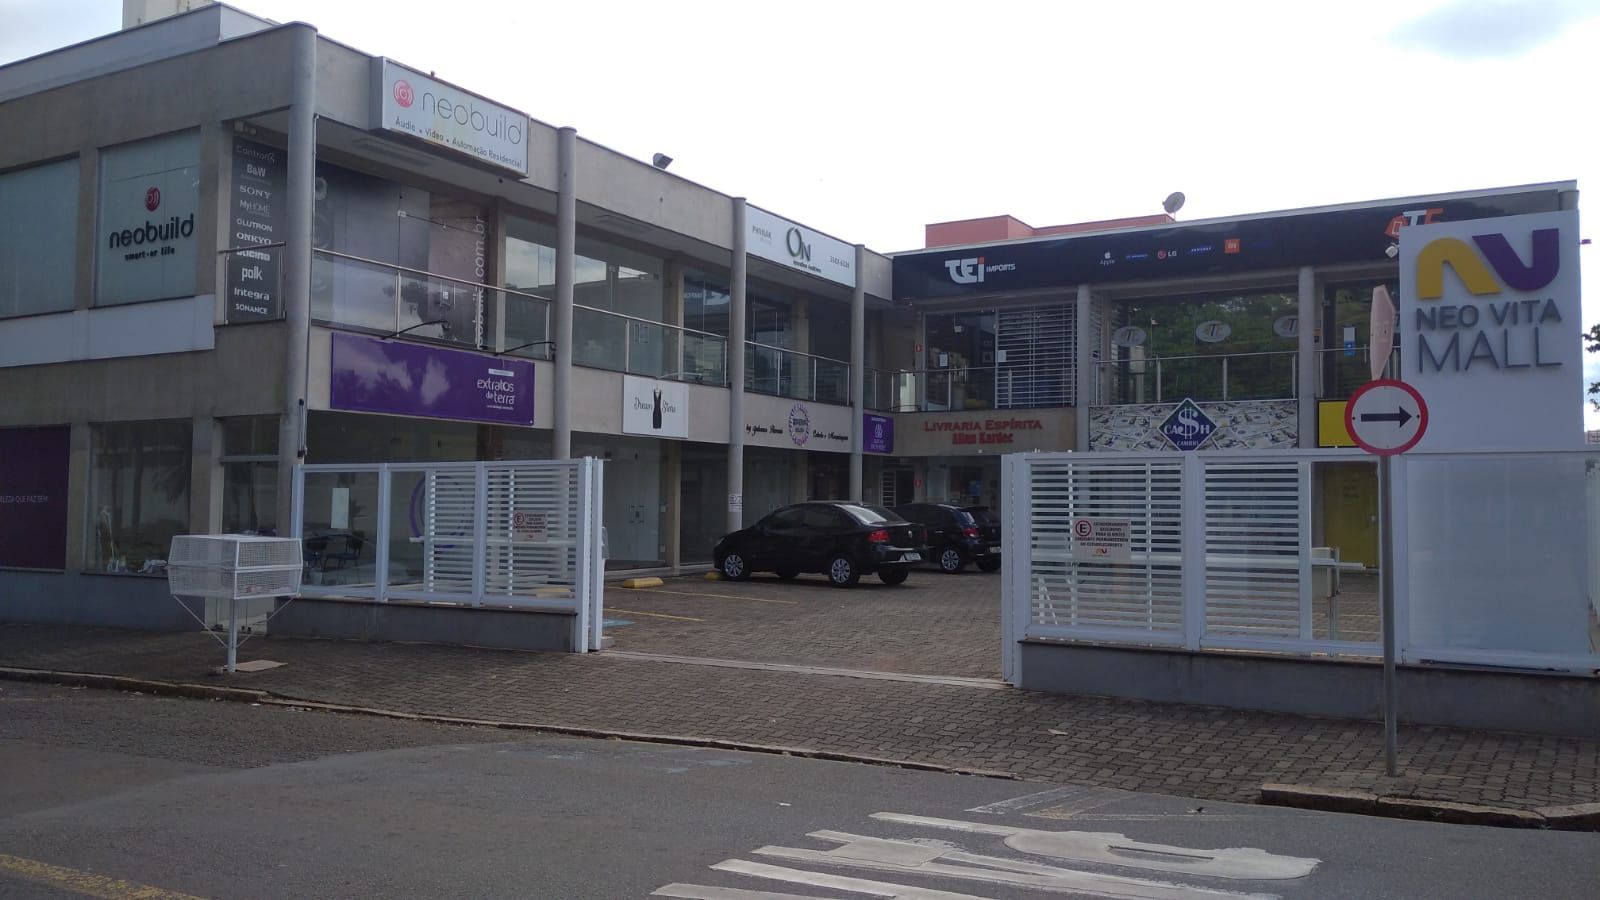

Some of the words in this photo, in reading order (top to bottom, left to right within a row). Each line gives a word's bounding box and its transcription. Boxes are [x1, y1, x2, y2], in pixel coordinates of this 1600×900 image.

[423, 92, 522, 145] neobuild
[452, 136, 487, 157] Automação
[488, 148, 522, 169] Residencial
[240, 185, 272, 199] SONY
[109, 213, 194, 249] neobuild
[236, 231, 272, 246] ONKYO
[786, 226, 812, 262] ON
[241, 265, 263, 282] polk
[985, 263, 1017, 273] IMPORTS
[233, 287, 270, 301] Integra
[235, 303, 268, 315] SONANCE
[1415, 303, 1480, 331] NEO
[1489, 298, 1563, 326] VITA
[1417, 325, 1564, 374] MALL
[476, 377, 515, 393] extratos
[494, 391, 516, 405] terra
[633, 396, 653, 410] Dream
[1079, 523, 1087, 533] E
